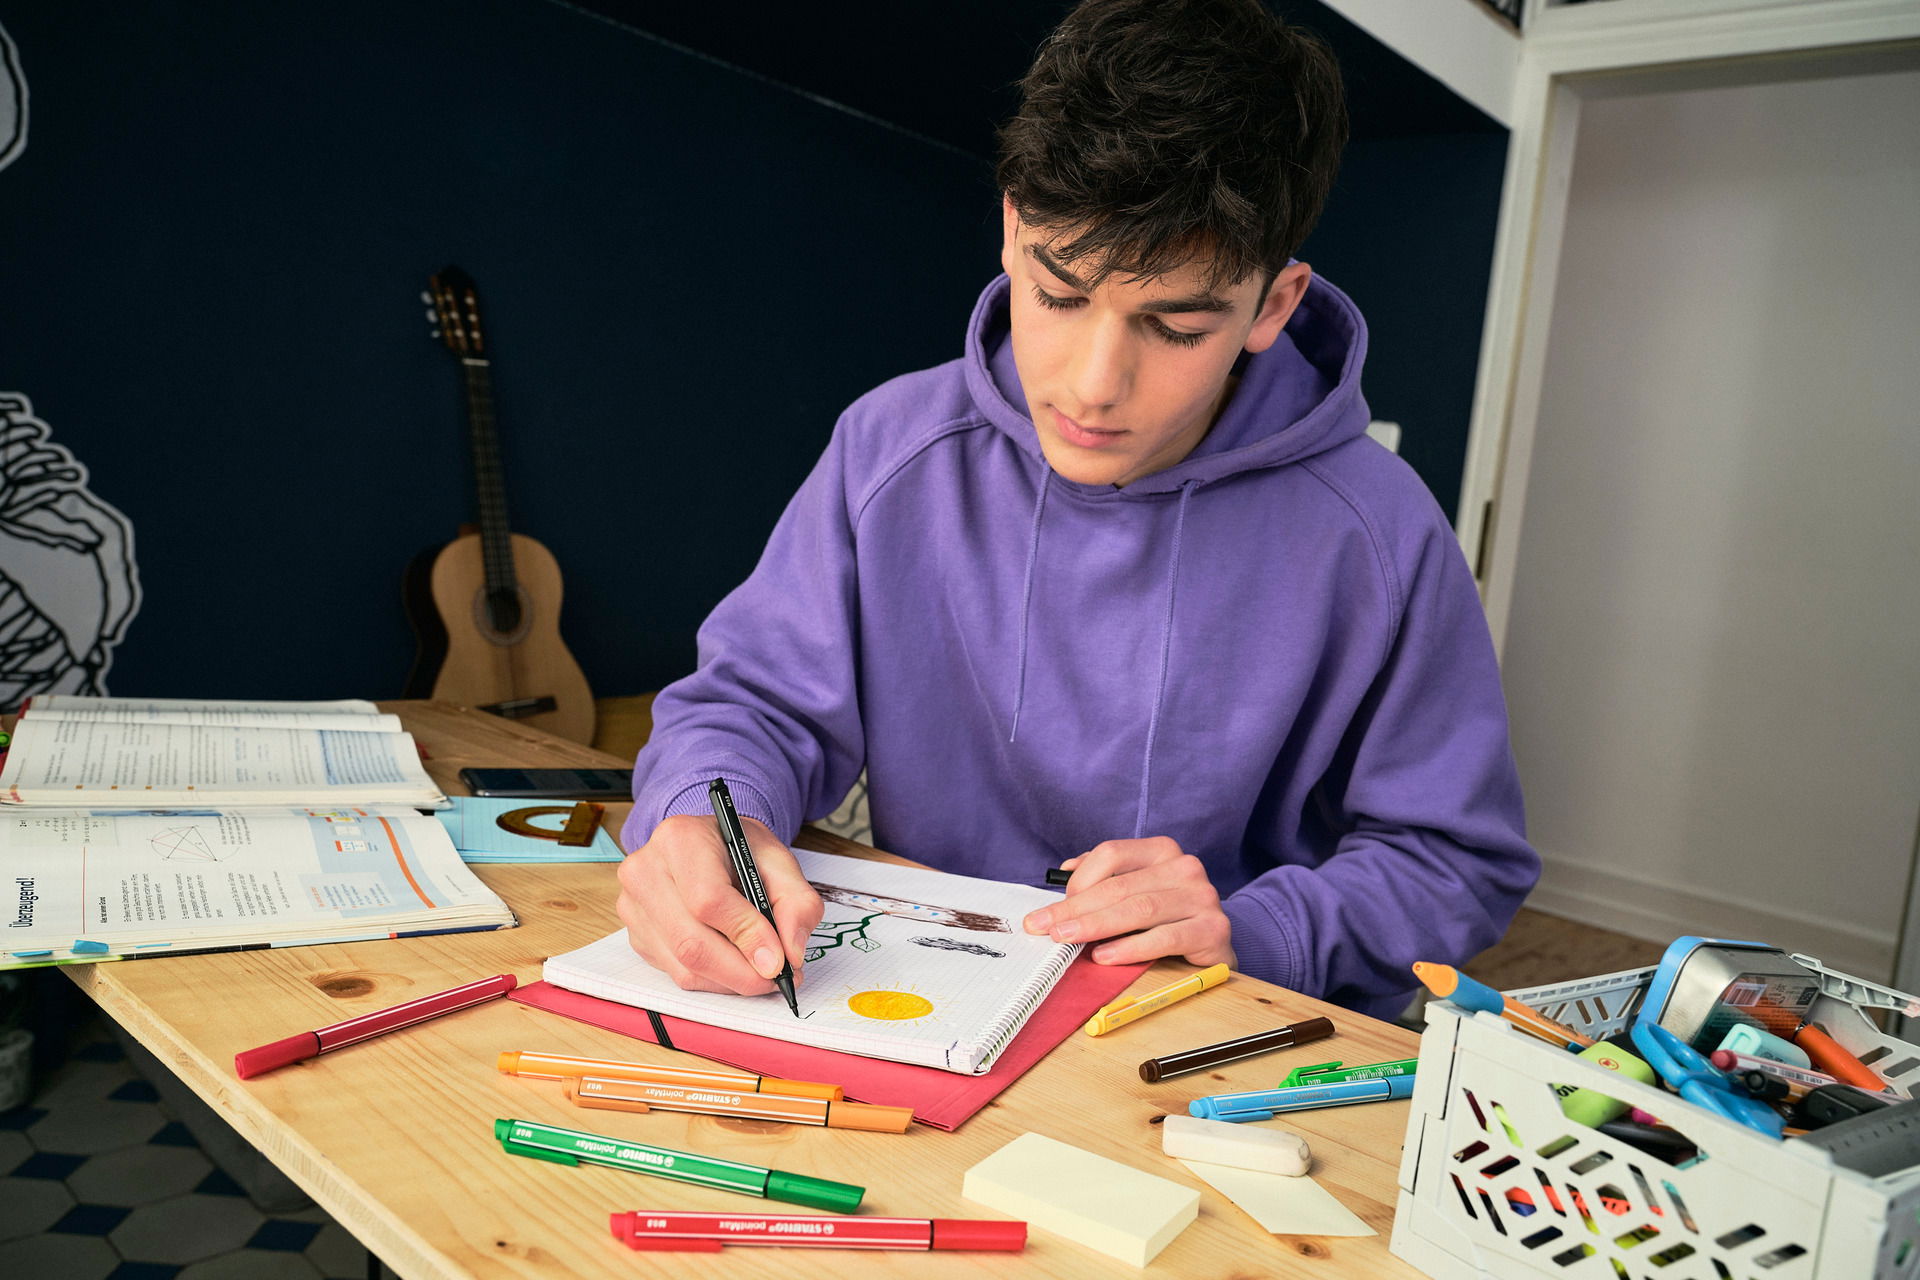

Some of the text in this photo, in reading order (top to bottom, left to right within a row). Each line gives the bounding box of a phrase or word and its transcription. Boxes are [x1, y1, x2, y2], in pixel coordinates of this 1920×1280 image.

[8, 877, 39, 928] Überzeugend!
[645, 1088, 684, 1098] pointMax
[575, 1140, 616, 1154] pointMax
[719, 1220, 766, 1232] pointMax
